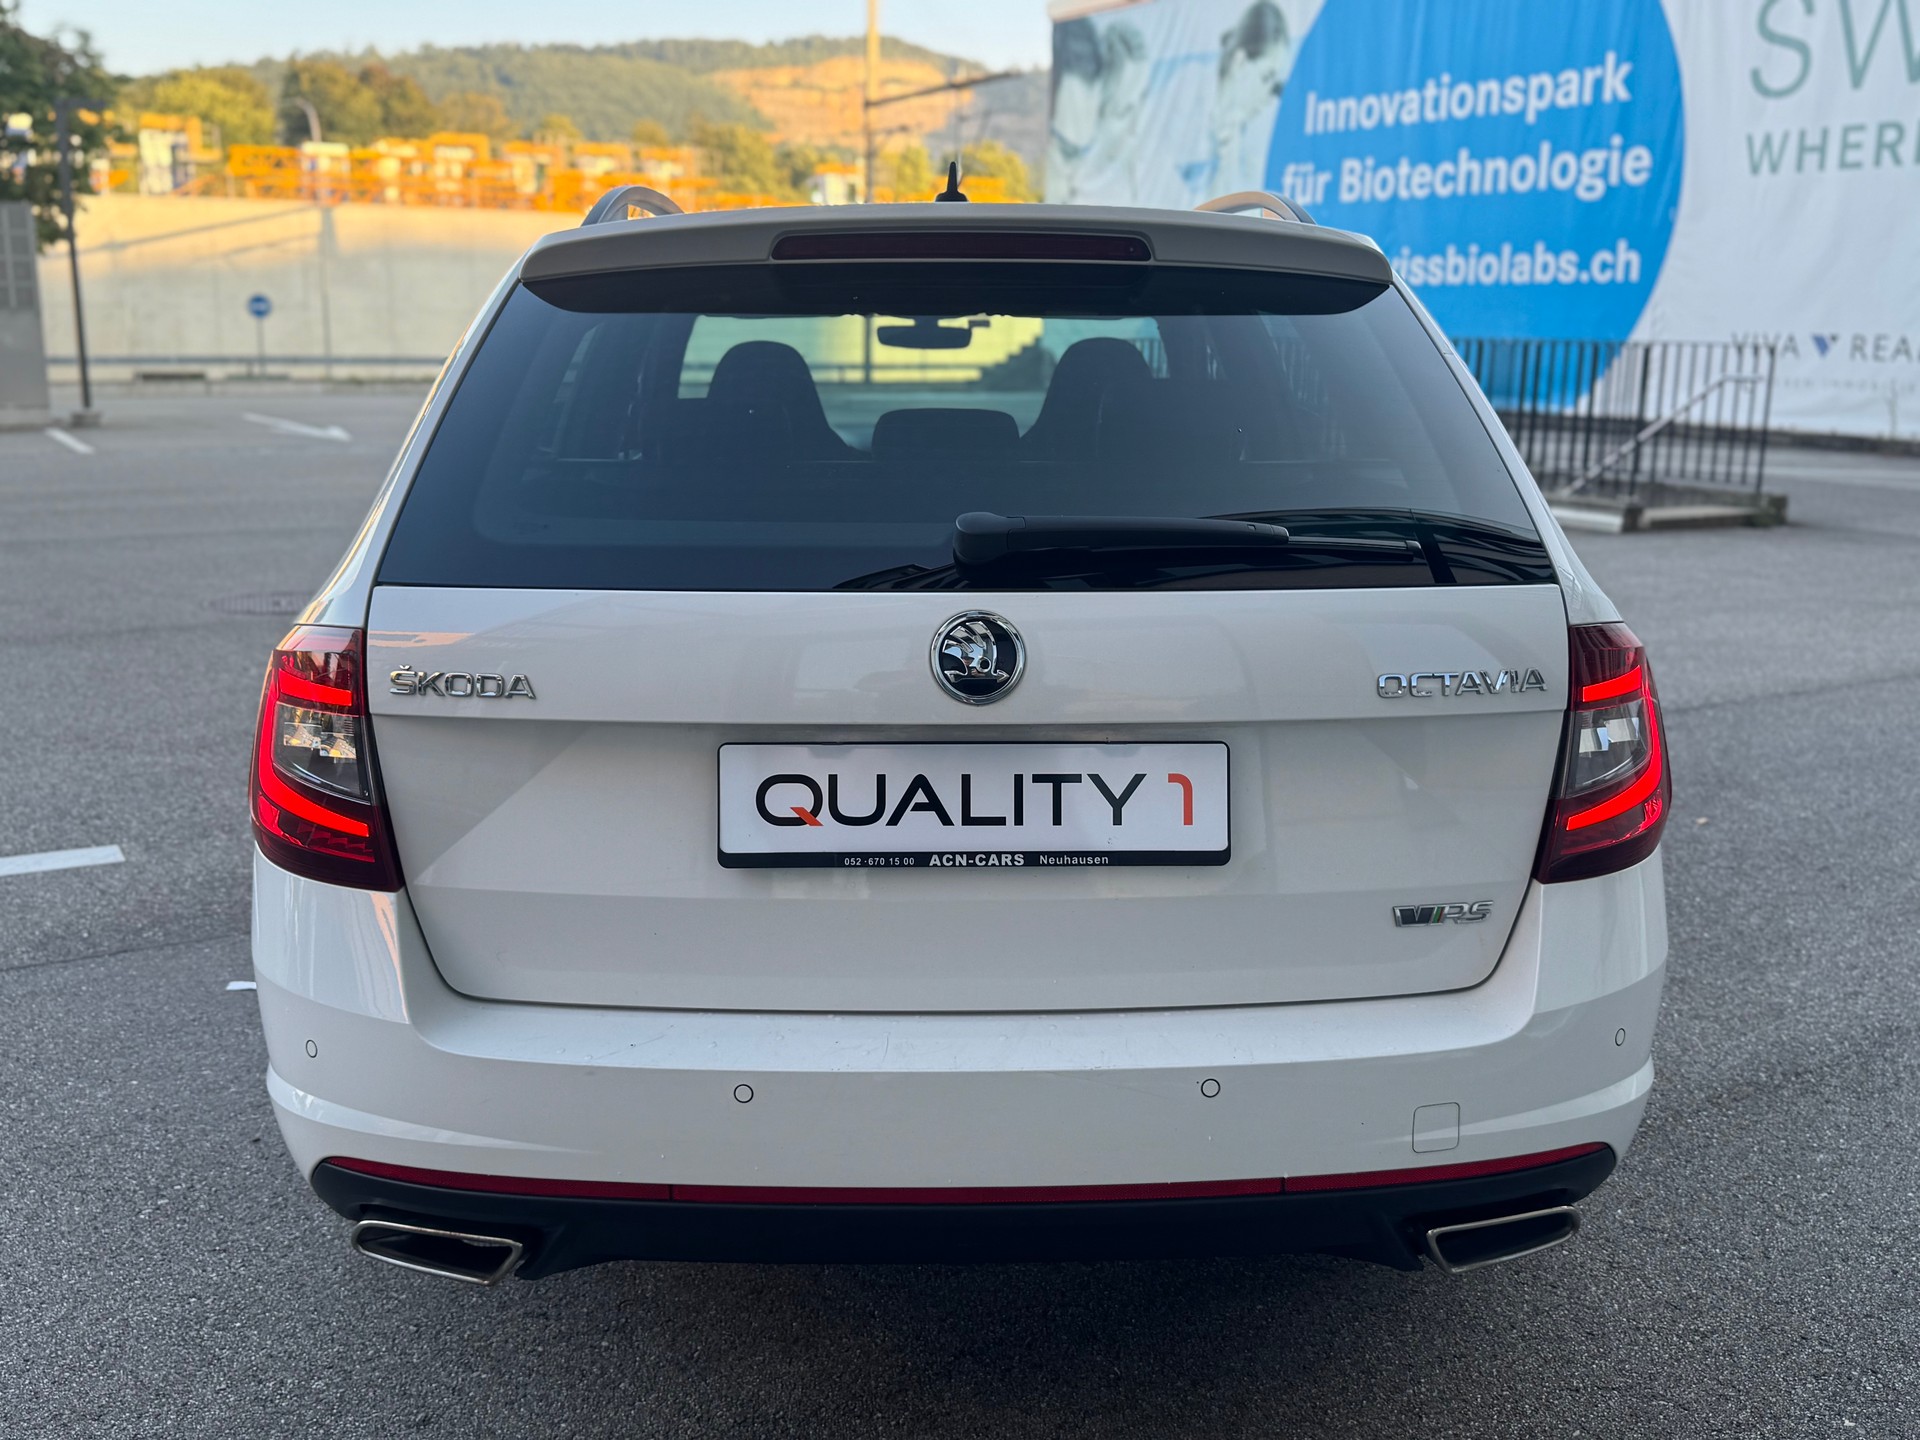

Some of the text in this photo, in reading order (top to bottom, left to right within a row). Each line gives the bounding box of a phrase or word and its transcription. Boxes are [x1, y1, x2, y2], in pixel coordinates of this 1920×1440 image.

[1304, 50, 1633, 135] Innovationspark
[1282, 134, 1653, 204] für Biotechnologie
[1747, 119, 1920, 175] WHER
[1851, 333, 1920, 363] REA
[389, 664, 536, 700] ŠKODA
[1377, 667, 1548, 698] OCTAVIA
[755, 773, 1147, 827] QUALITY
[889, 858, 900, 866] 15
[903, 858, 915, 866] 00
[929, 854, 1025, 867] ACN-CARS
[1039, 855, 1109, 865] Neuhausen
